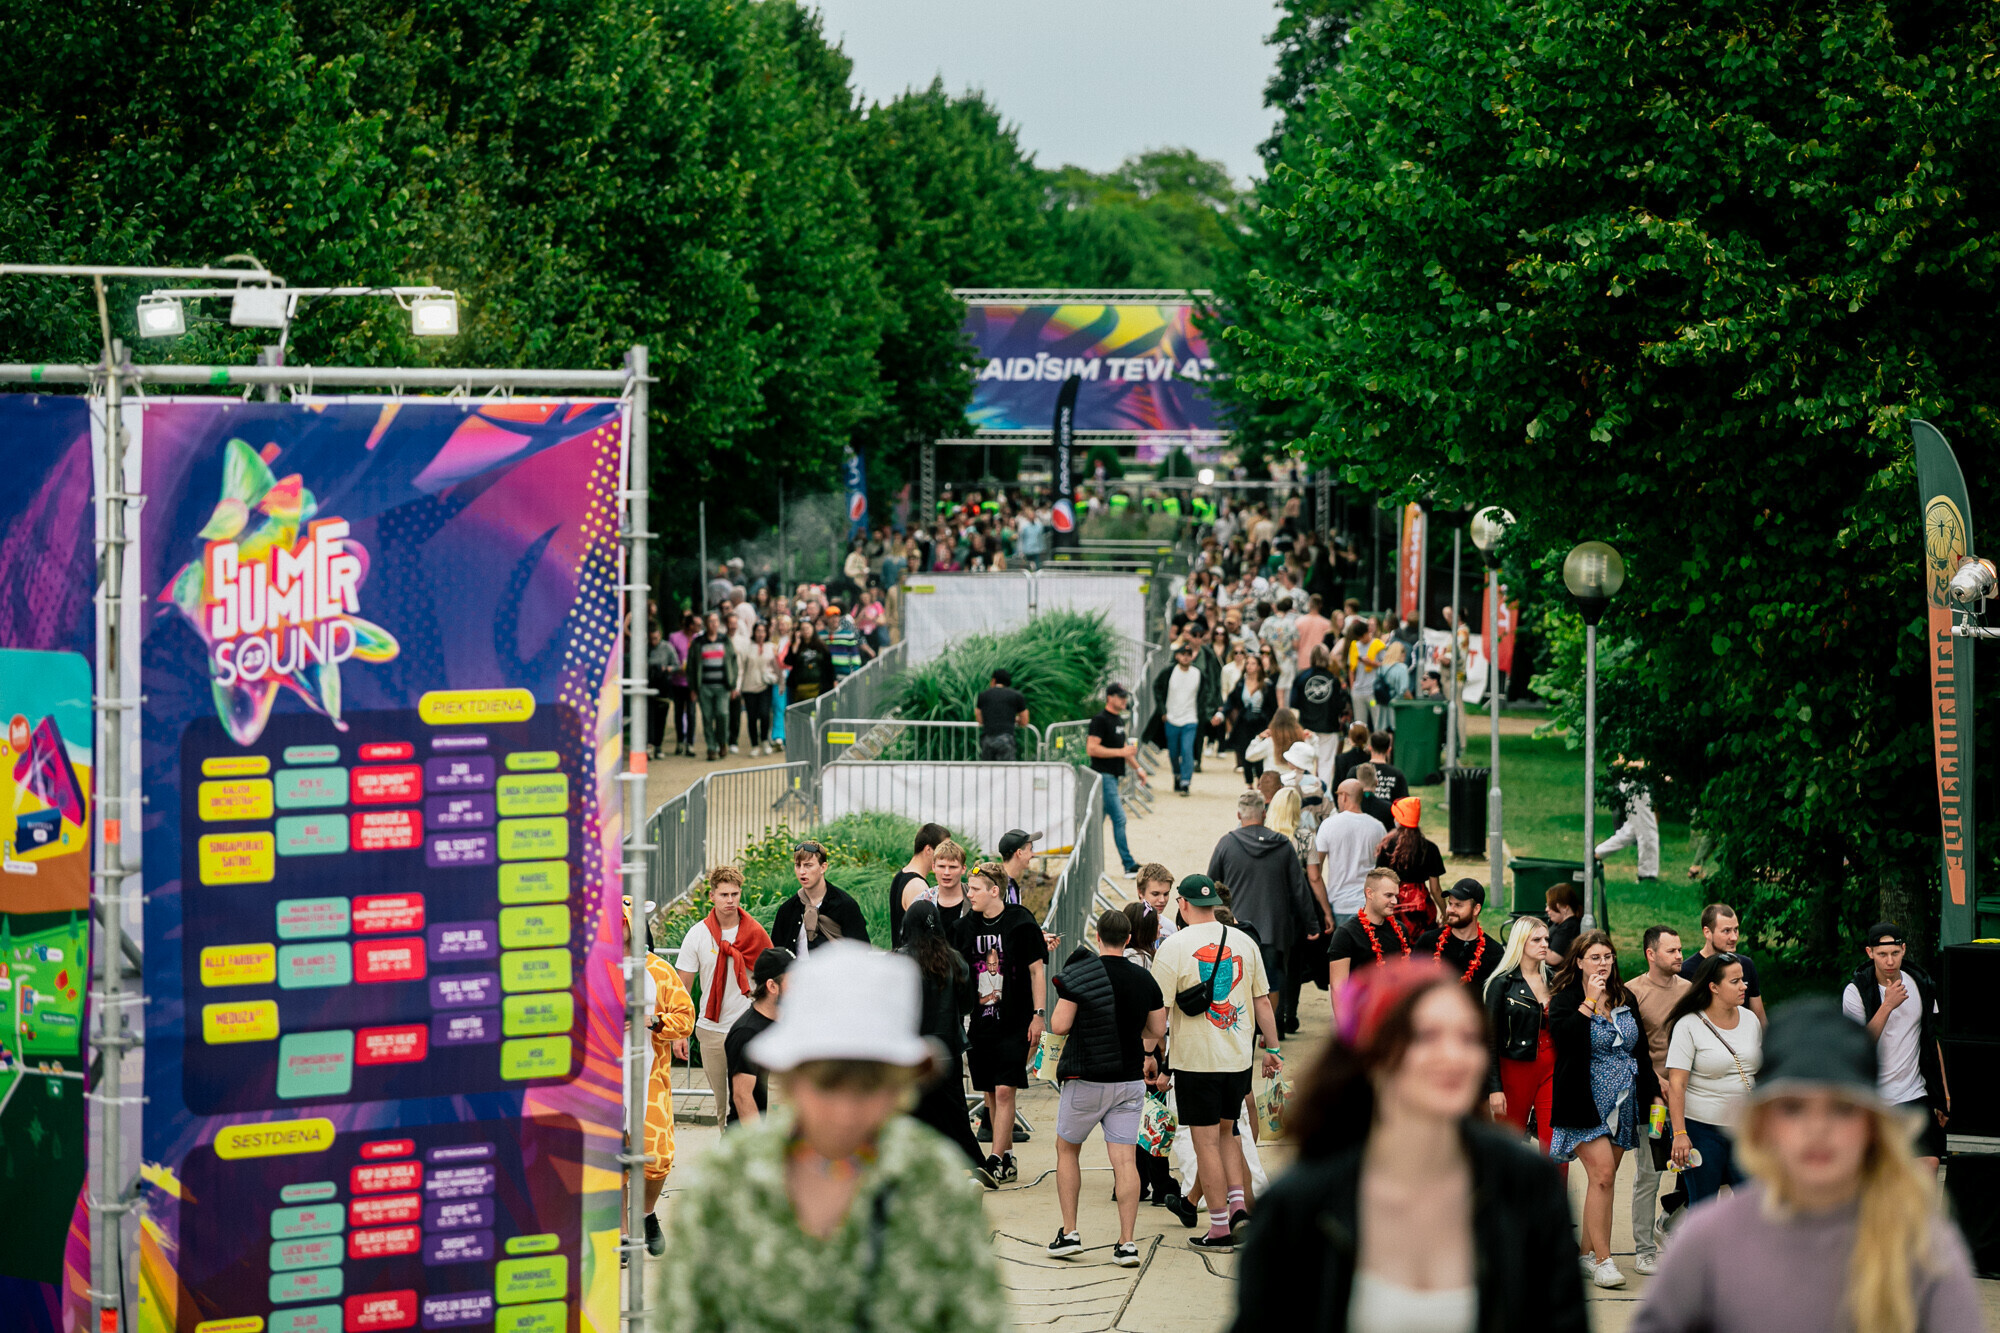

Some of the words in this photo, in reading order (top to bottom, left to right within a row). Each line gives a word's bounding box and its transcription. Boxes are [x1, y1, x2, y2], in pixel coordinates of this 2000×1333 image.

[961, 352, 1102, 382] AIDĪSIM
[1106, 357, 1173, 382] TEVI
[205, 516, 362, 640] SUMMER
[213, 619, 358, 687] SOUND
[431, 697, 524, 716] PIEKTDIENA
[972, 933, 1003, 954] UPA
[231, 1127, 322, 1149] SESTDIENA
